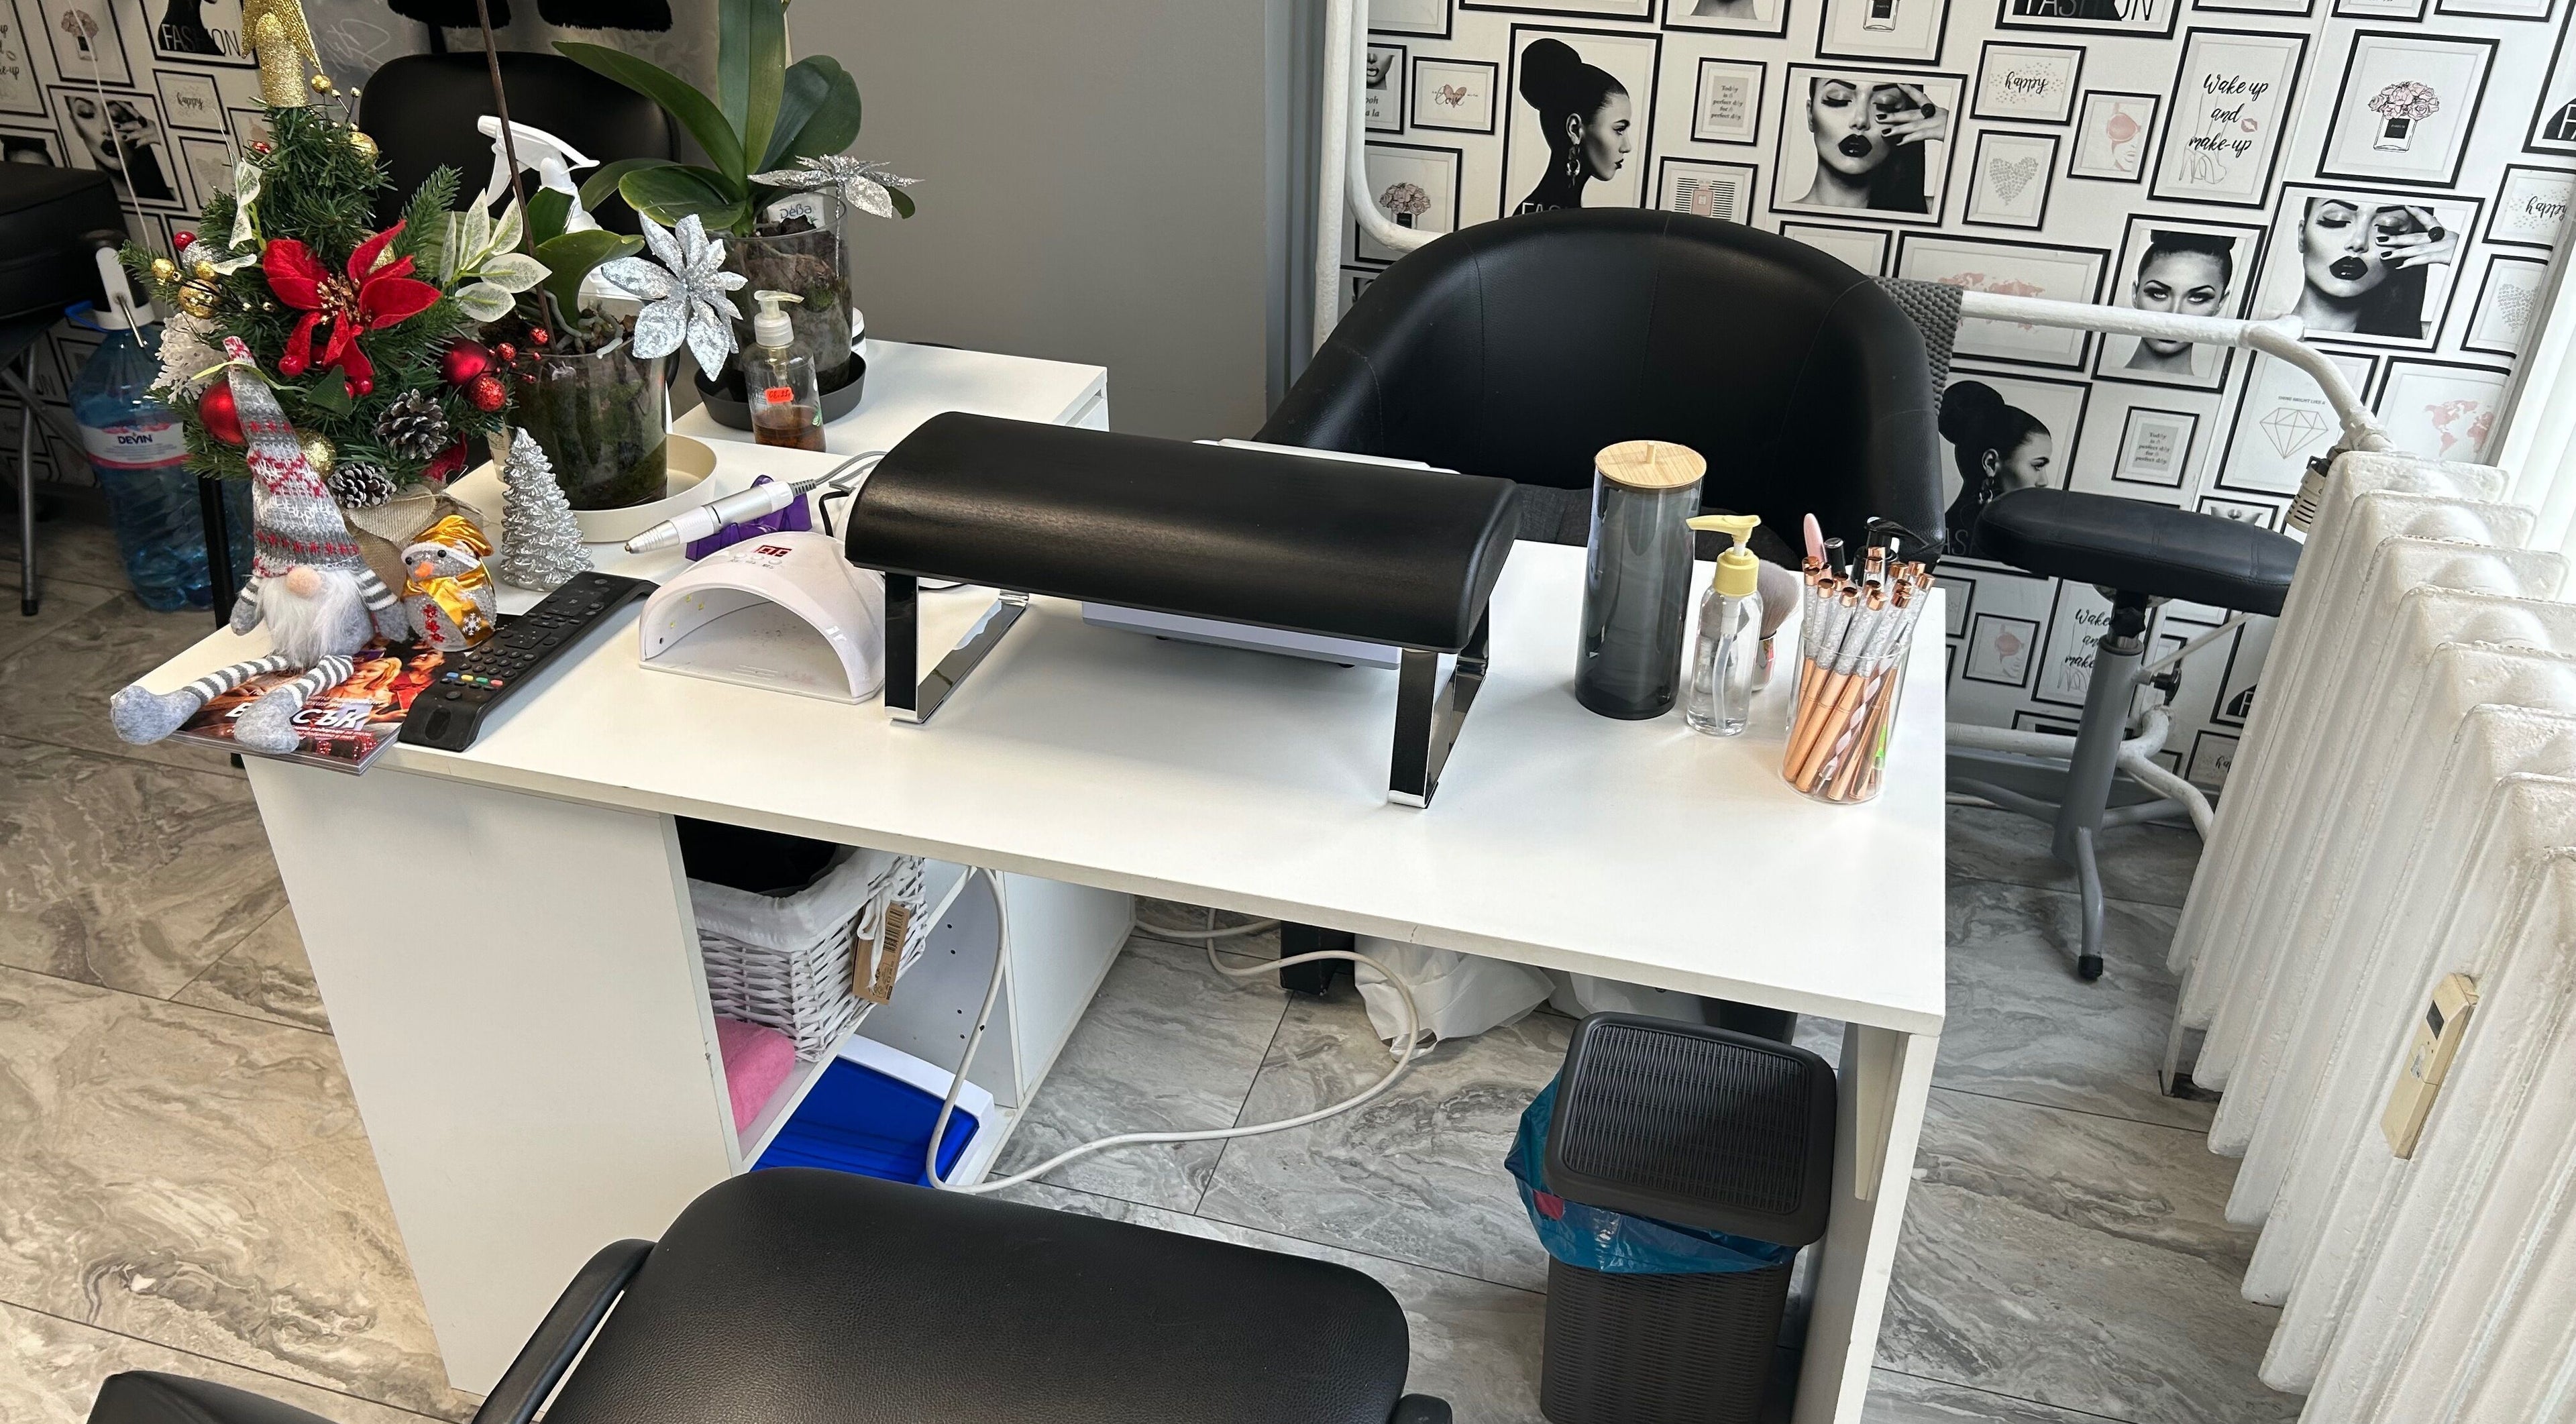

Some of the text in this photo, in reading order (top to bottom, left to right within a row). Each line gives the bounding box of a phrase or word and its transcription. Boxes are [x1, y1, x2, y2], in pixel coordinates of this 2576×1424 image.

[2004, 71, 2049, 95] happy
[2203, 74, 2269, 101] Wake up
[2210, 103, 2245, 123] and
[2188, 132, 2252, 159] make-up
[2525, 195, 2567, 221] happy
[117, 435, 153, 445] DEVIN
[2075, 609, 2110, 626] Wake
[2082, 635, 2099, 647] an
